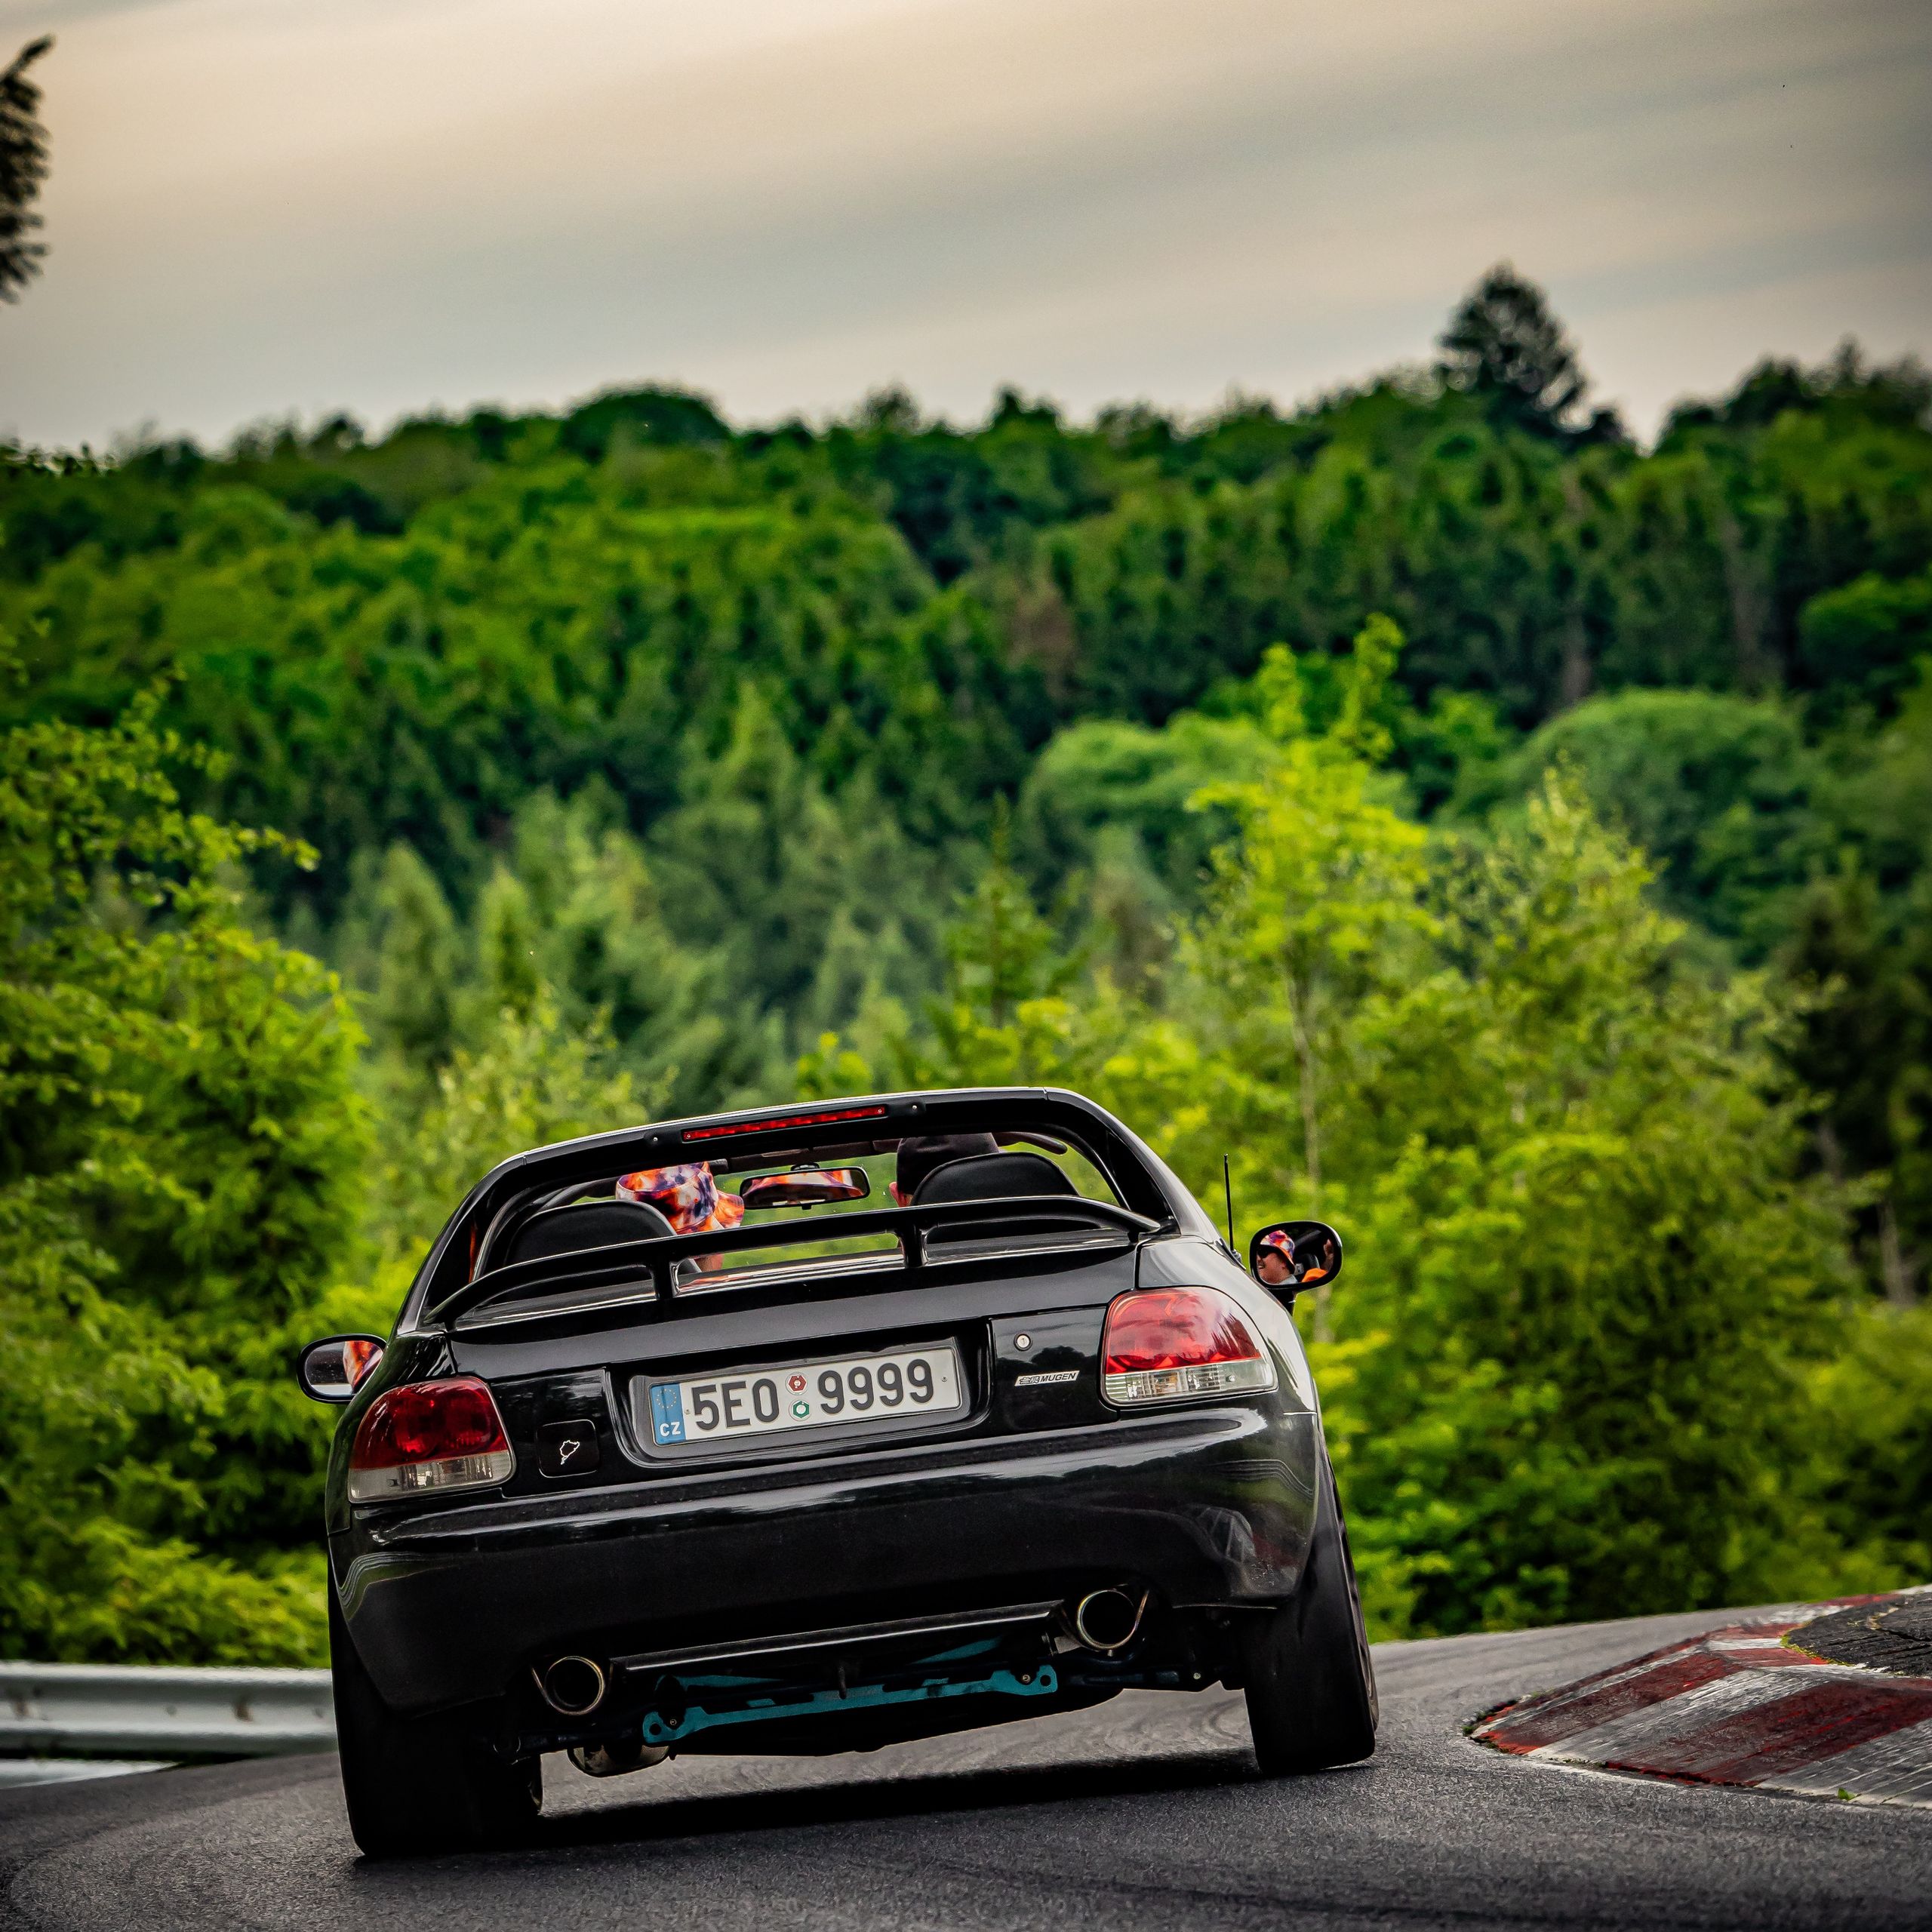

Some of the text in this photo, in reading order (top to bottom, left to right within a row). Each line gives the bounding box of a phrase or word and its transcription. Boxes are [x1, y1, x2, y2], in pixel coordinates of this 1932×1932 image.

[1041, 1374, 1075, 1382] MUGEN
[691, 1358, 934, 1431] 5E0 9999
[660, 1421, 681, 1437] CZ
